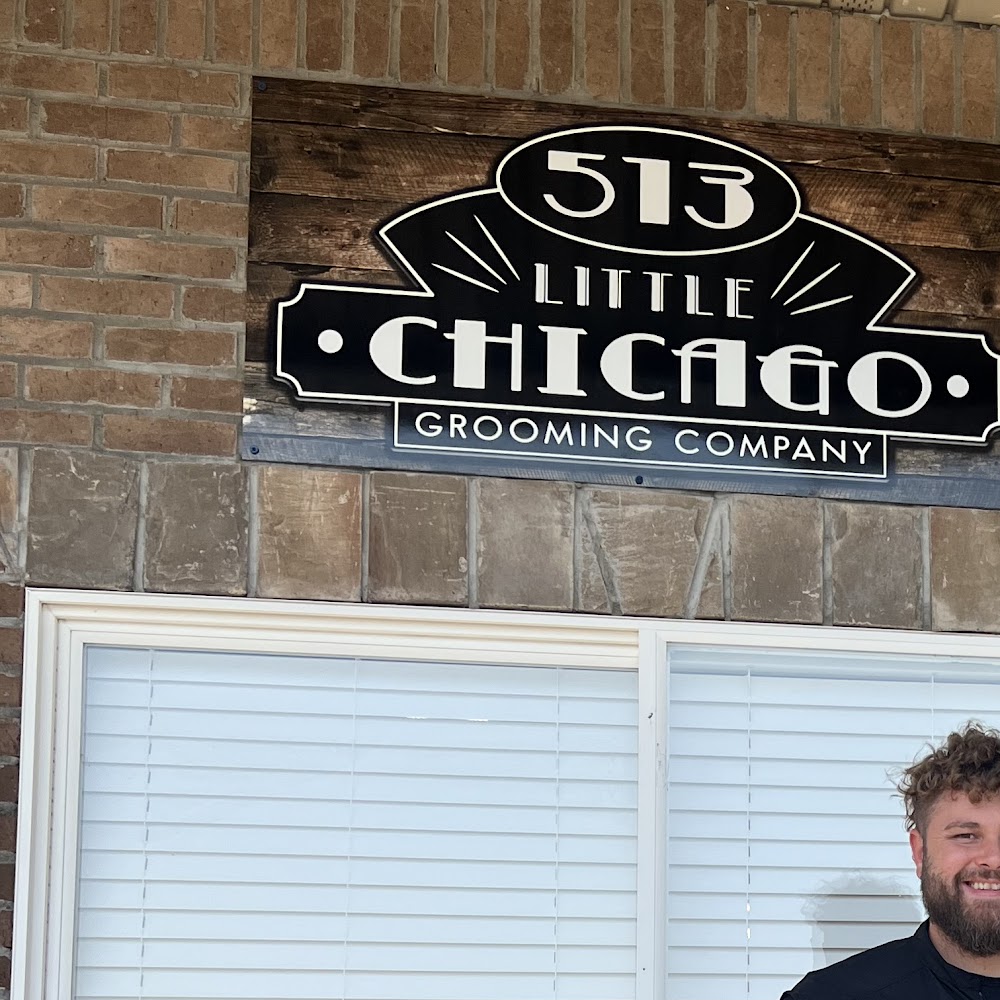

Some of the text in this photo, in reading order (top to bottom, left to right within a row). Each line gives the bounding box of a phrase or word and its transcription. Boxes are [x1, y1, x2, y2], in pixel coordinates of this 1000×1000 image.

[542, 149, 756, 230] 513
[534, 262, 755, 320] LITTLE
[368, 315, 933, 418] CHICAGO
[415, 411, 874, 466] GROOMING COMPANY
